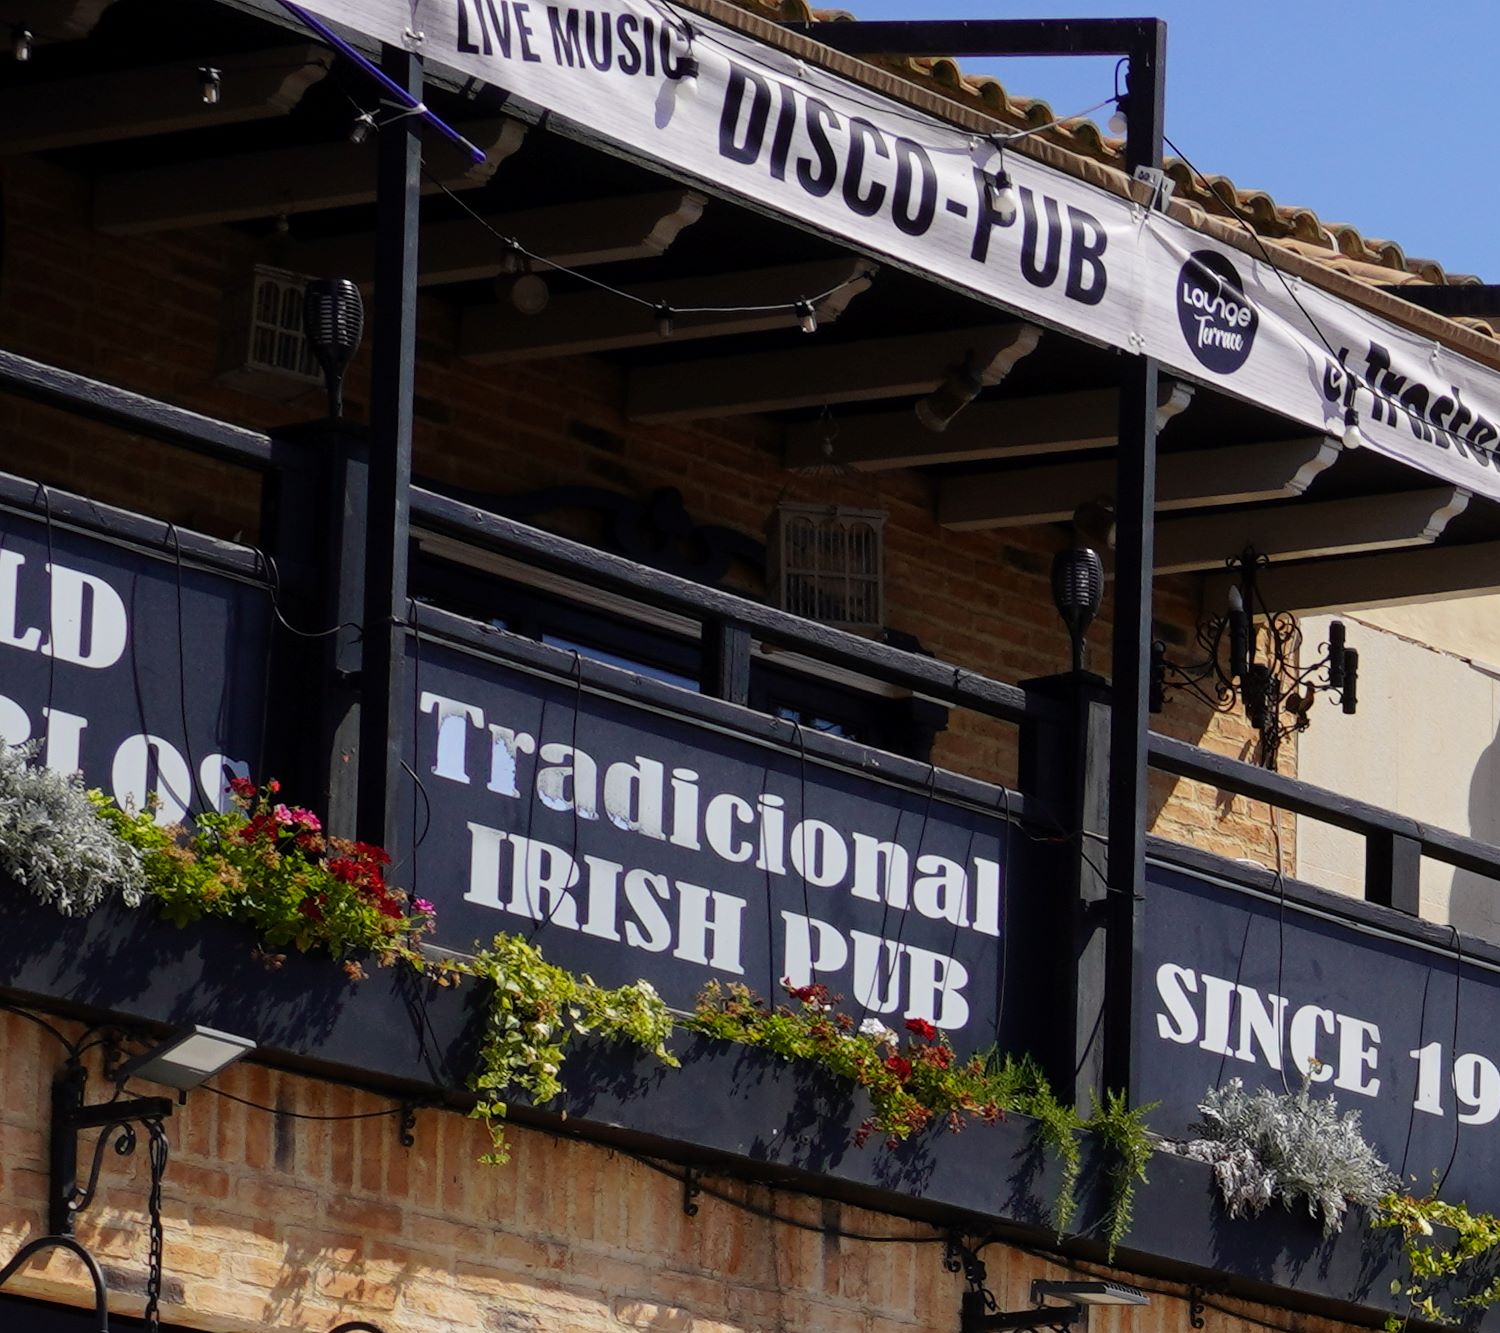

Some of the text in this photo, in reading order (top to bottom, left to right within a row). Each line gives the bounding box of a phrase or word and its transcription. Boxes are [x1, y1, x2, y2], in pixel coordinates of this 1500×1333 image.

[457, 0, 692, 80] LIVE MUSIC
[1193, 313, 1244, 352] Terrace
[419, 690, 1001, 938] Tradicional
[464, 821, 970, 1032] IRISH PUB
[1155, 962, 1381, 1098] SINCE
